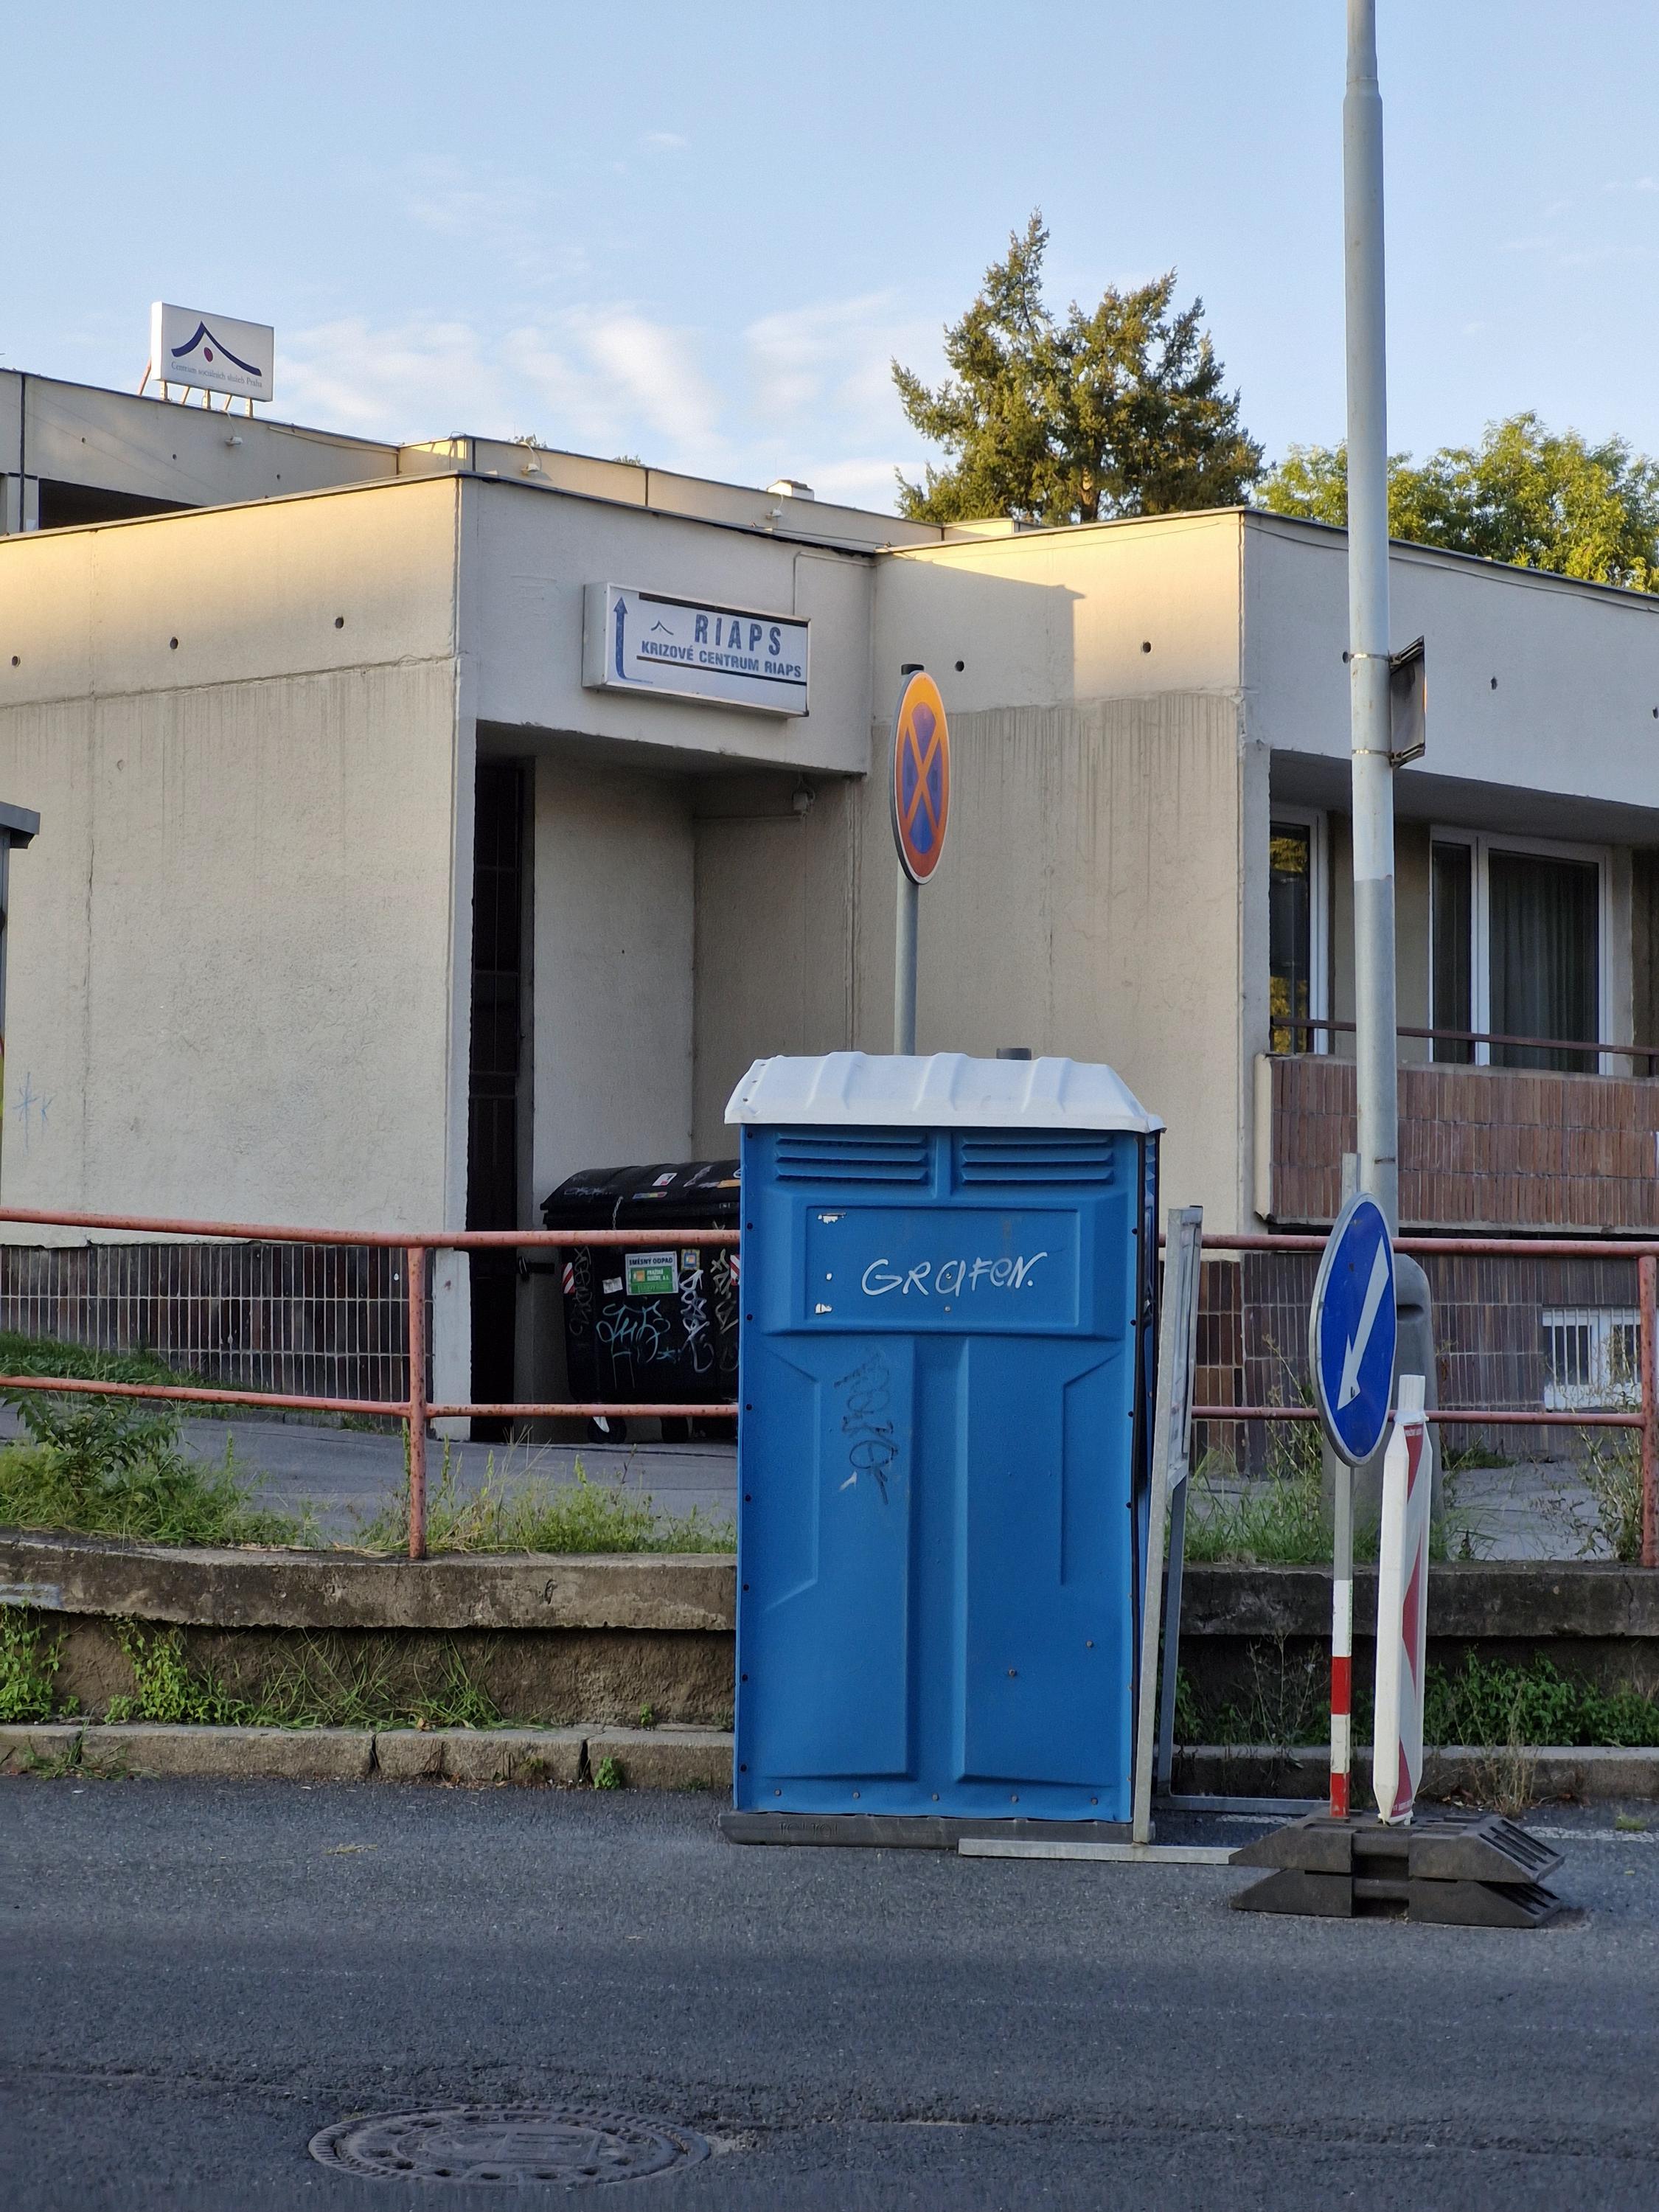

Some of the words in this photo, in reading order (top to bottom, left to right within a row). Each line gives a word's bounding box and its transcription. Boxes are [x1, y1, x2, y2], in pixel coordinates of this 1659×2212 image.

[695, 613, 782, 655] RIAPS
[641, 640, 694, 661] KRIZOVÉ
[699, 650, 759, 671] CENTRUM
[765, 661, 802, 678] RIAPS
